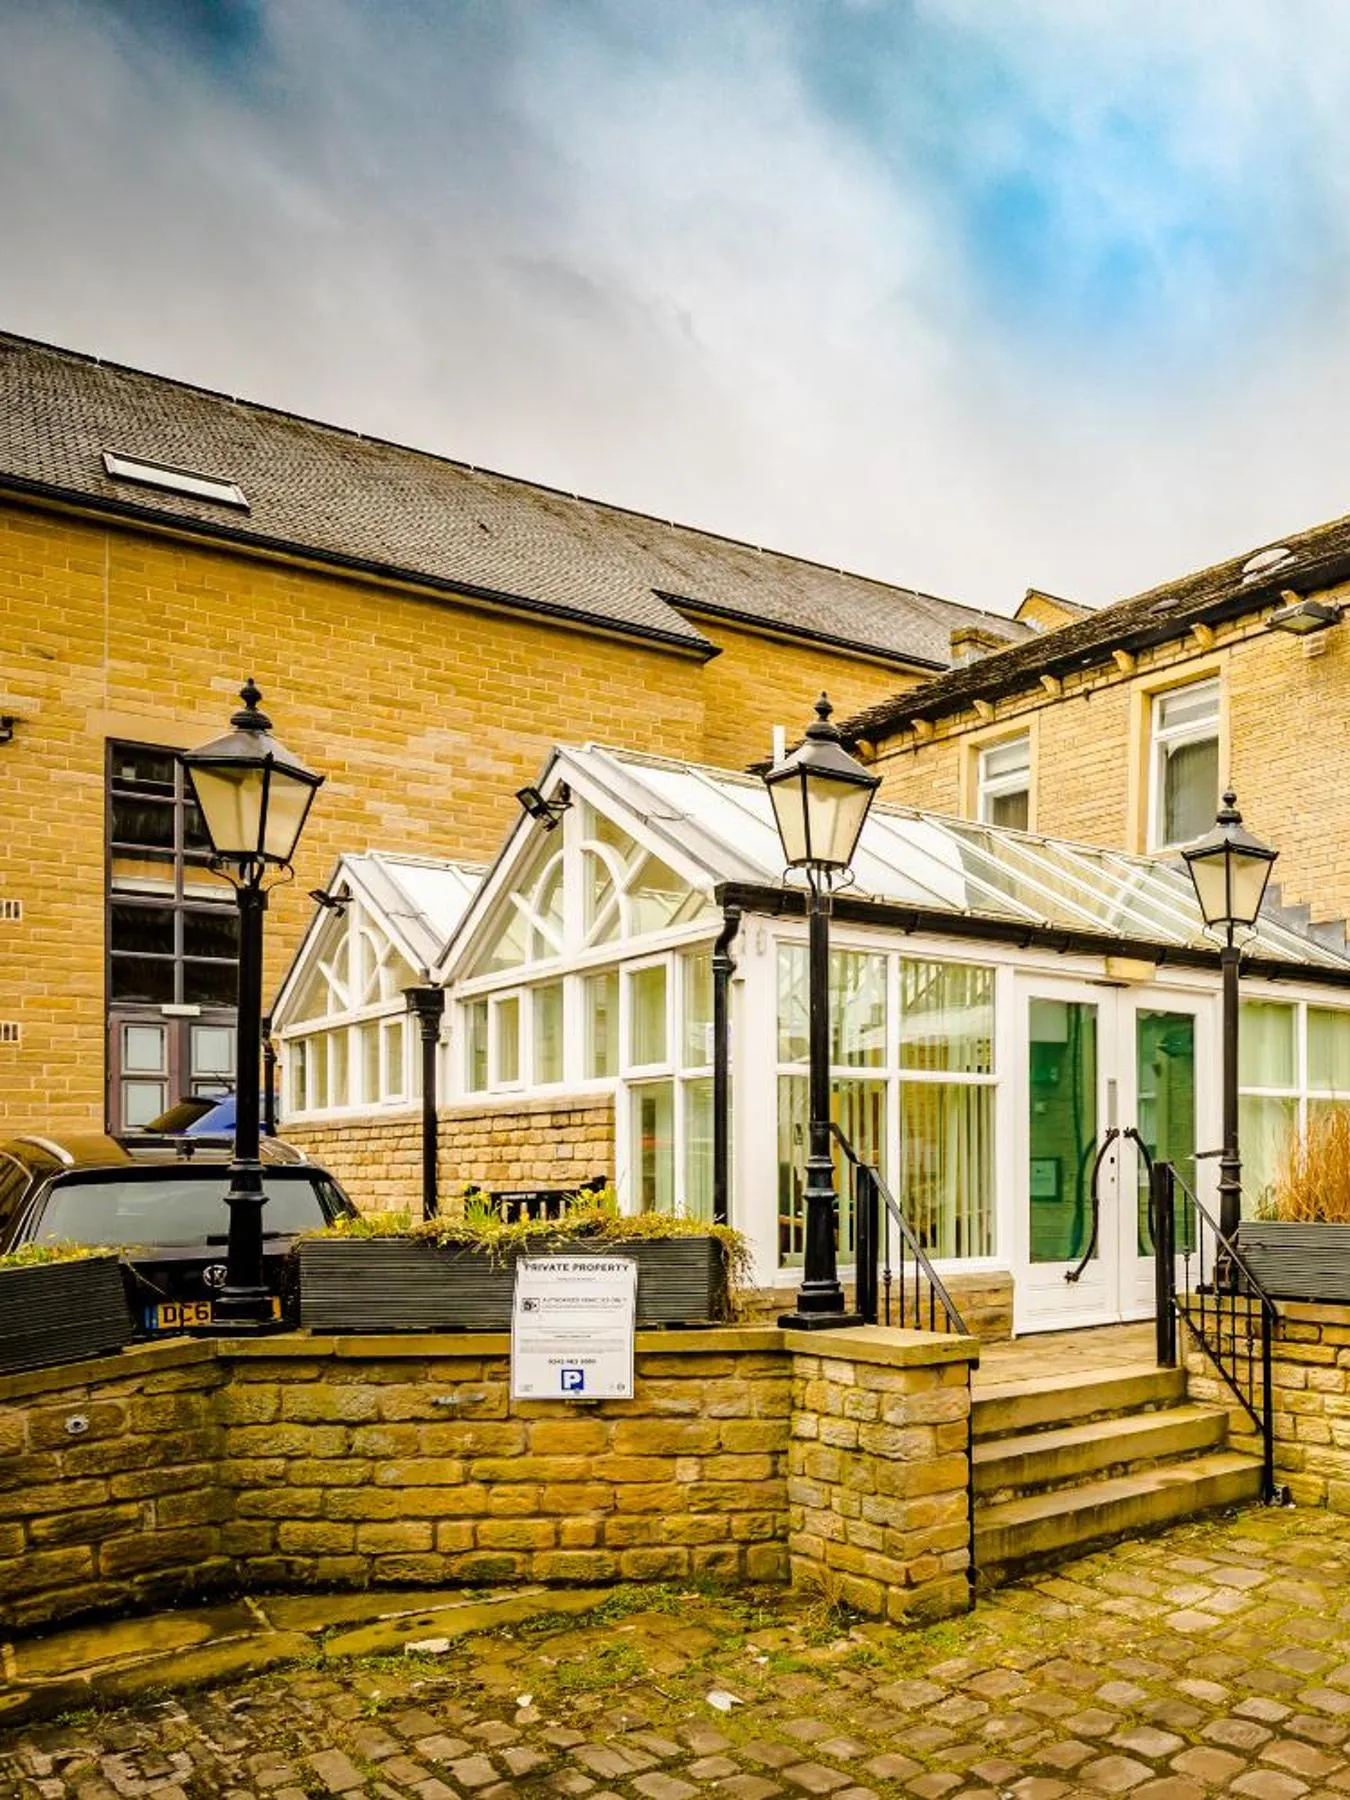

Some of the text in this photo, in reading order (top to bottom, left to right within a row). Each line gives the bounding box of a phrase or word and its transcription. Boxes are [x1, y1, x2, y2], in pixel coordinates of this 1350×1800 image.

[524, 1263, 630, 1272] PRIVATE PROPERTY
[162, 1302, 211, 1325] DC6
